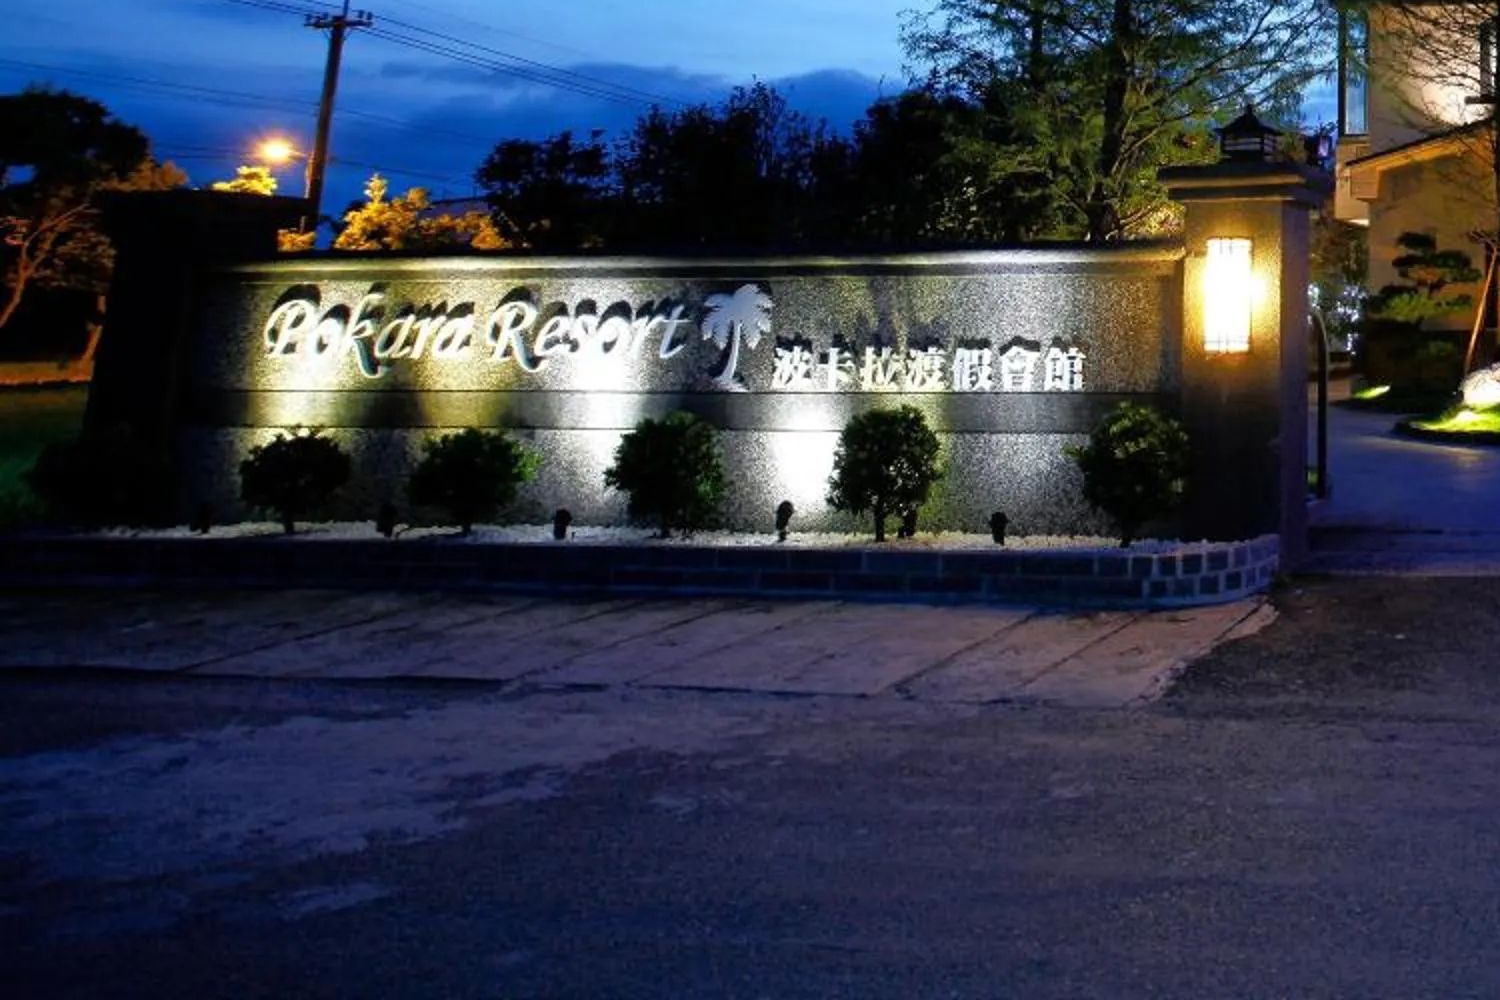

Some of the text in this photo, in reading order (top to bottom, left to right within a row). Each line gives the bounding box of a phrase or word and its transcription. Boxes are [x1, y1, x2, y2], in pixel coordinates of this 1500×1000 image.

[265, 292, 695, 377] Pokara Resort
[771, 346, 1087, 392] 波卡拉渡假會館
